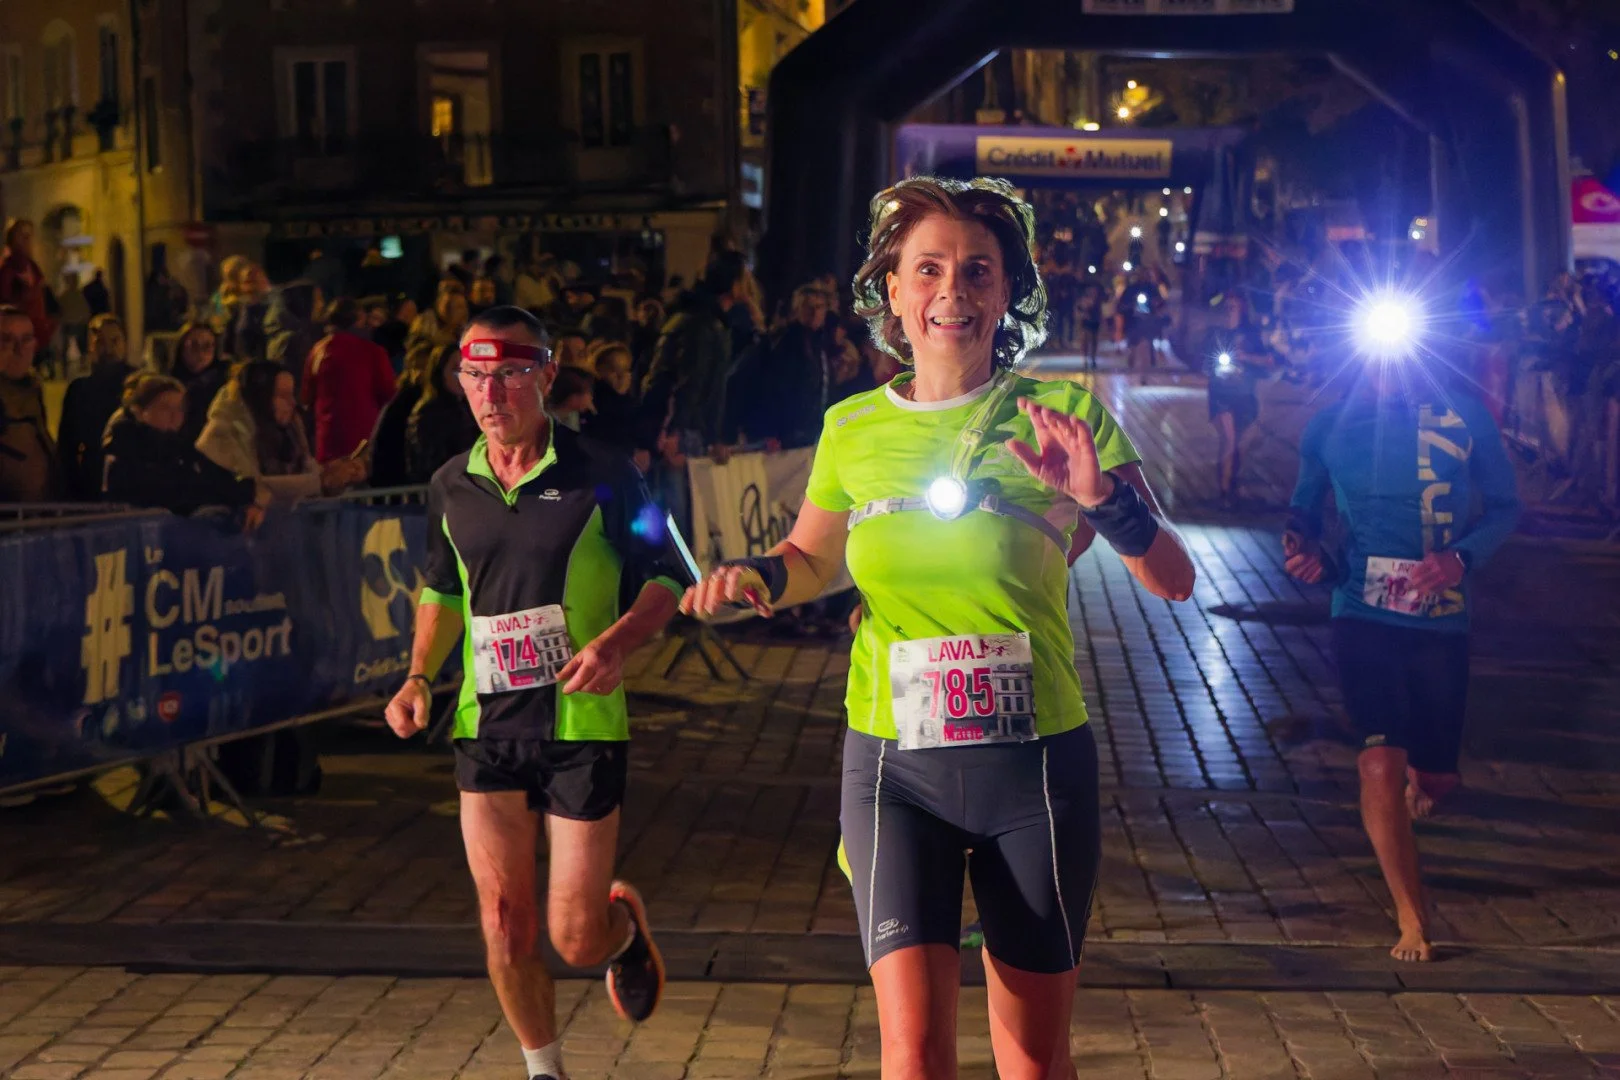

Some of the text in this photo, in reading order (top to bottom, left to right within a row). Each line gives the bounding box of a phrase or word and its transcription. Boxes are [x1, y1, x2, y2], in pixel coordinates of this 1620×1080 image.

[146, 566, 224, 628] CM
[148, 616, 292, 678] LeSport
[491, 634, 539, 672] 174
[923, 667, 996, 719] 785
